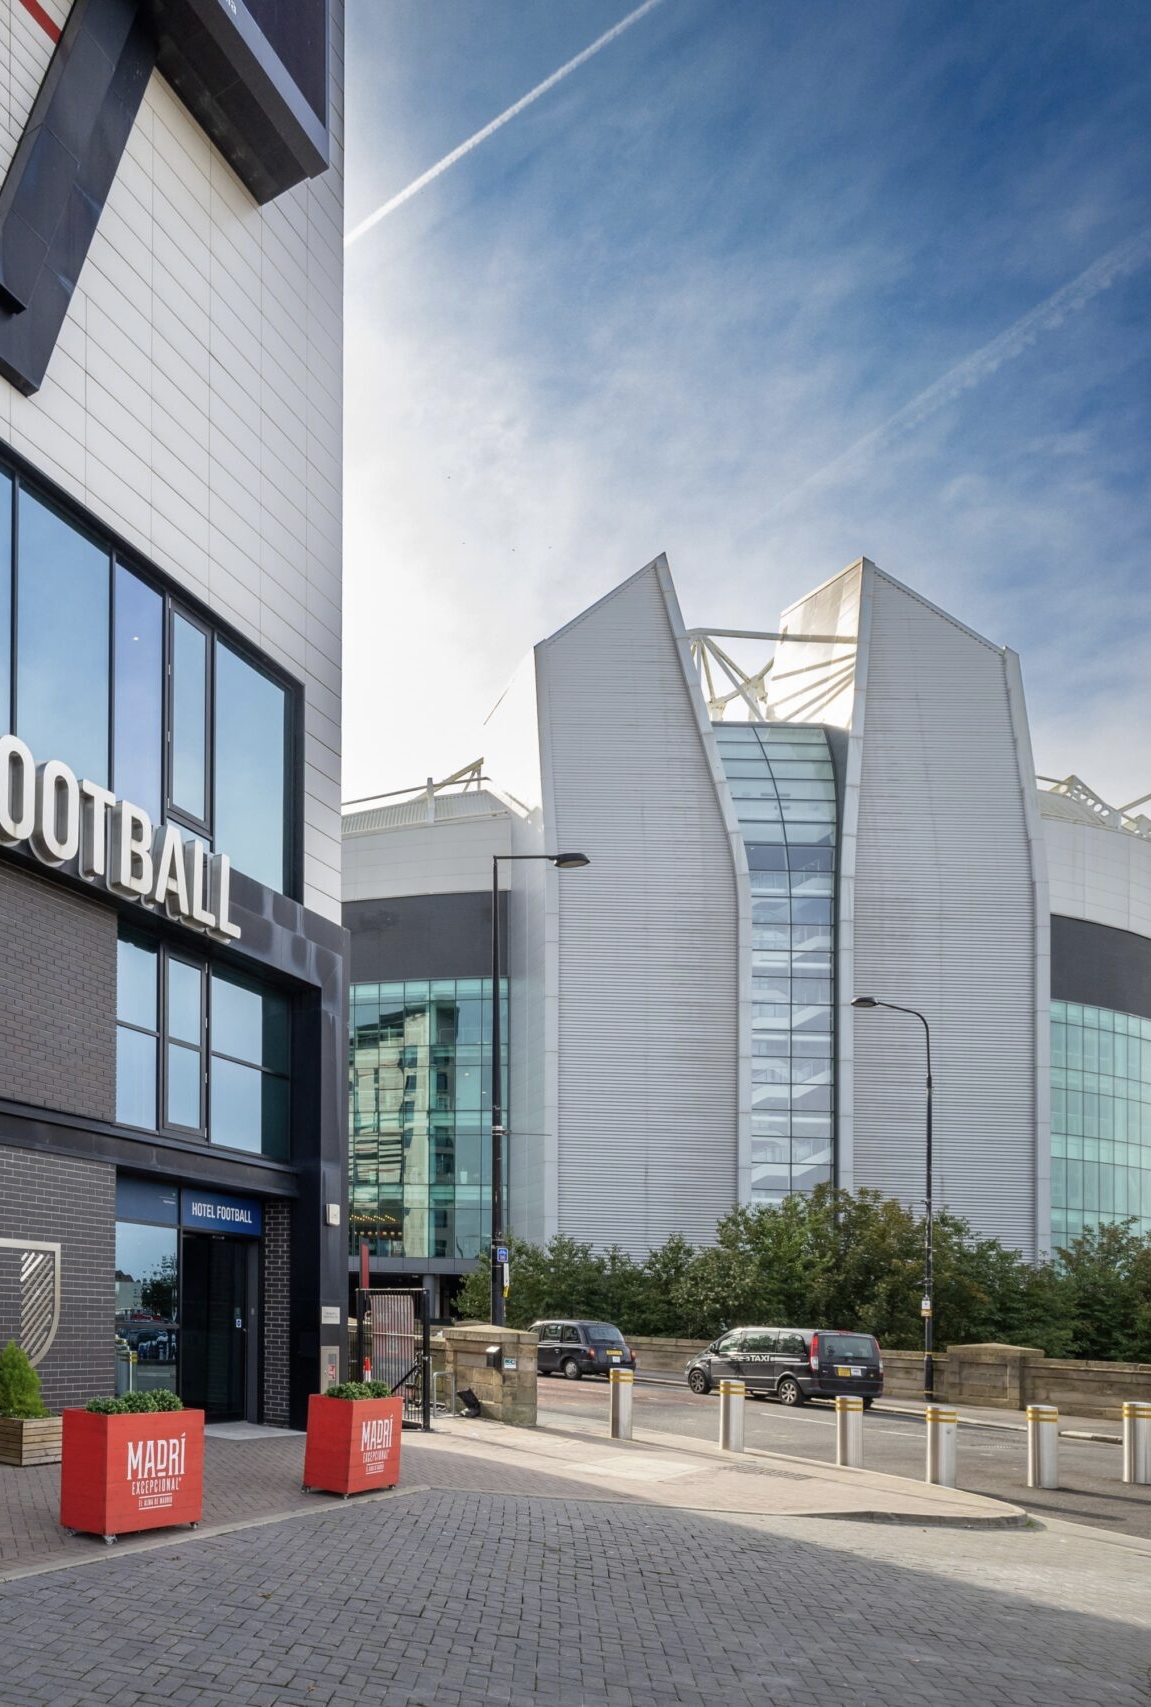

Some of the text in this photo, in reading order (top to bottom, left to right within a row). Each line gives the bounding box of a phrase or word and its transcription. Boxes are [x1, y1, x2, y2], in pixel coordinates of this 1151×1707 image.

[191, 1202, 252, 1224] HOTEL FOOTBALL
[361, 1413, 393, 1452] MADRÍ
[127, 1431, 186, 1481] MADRÍ
